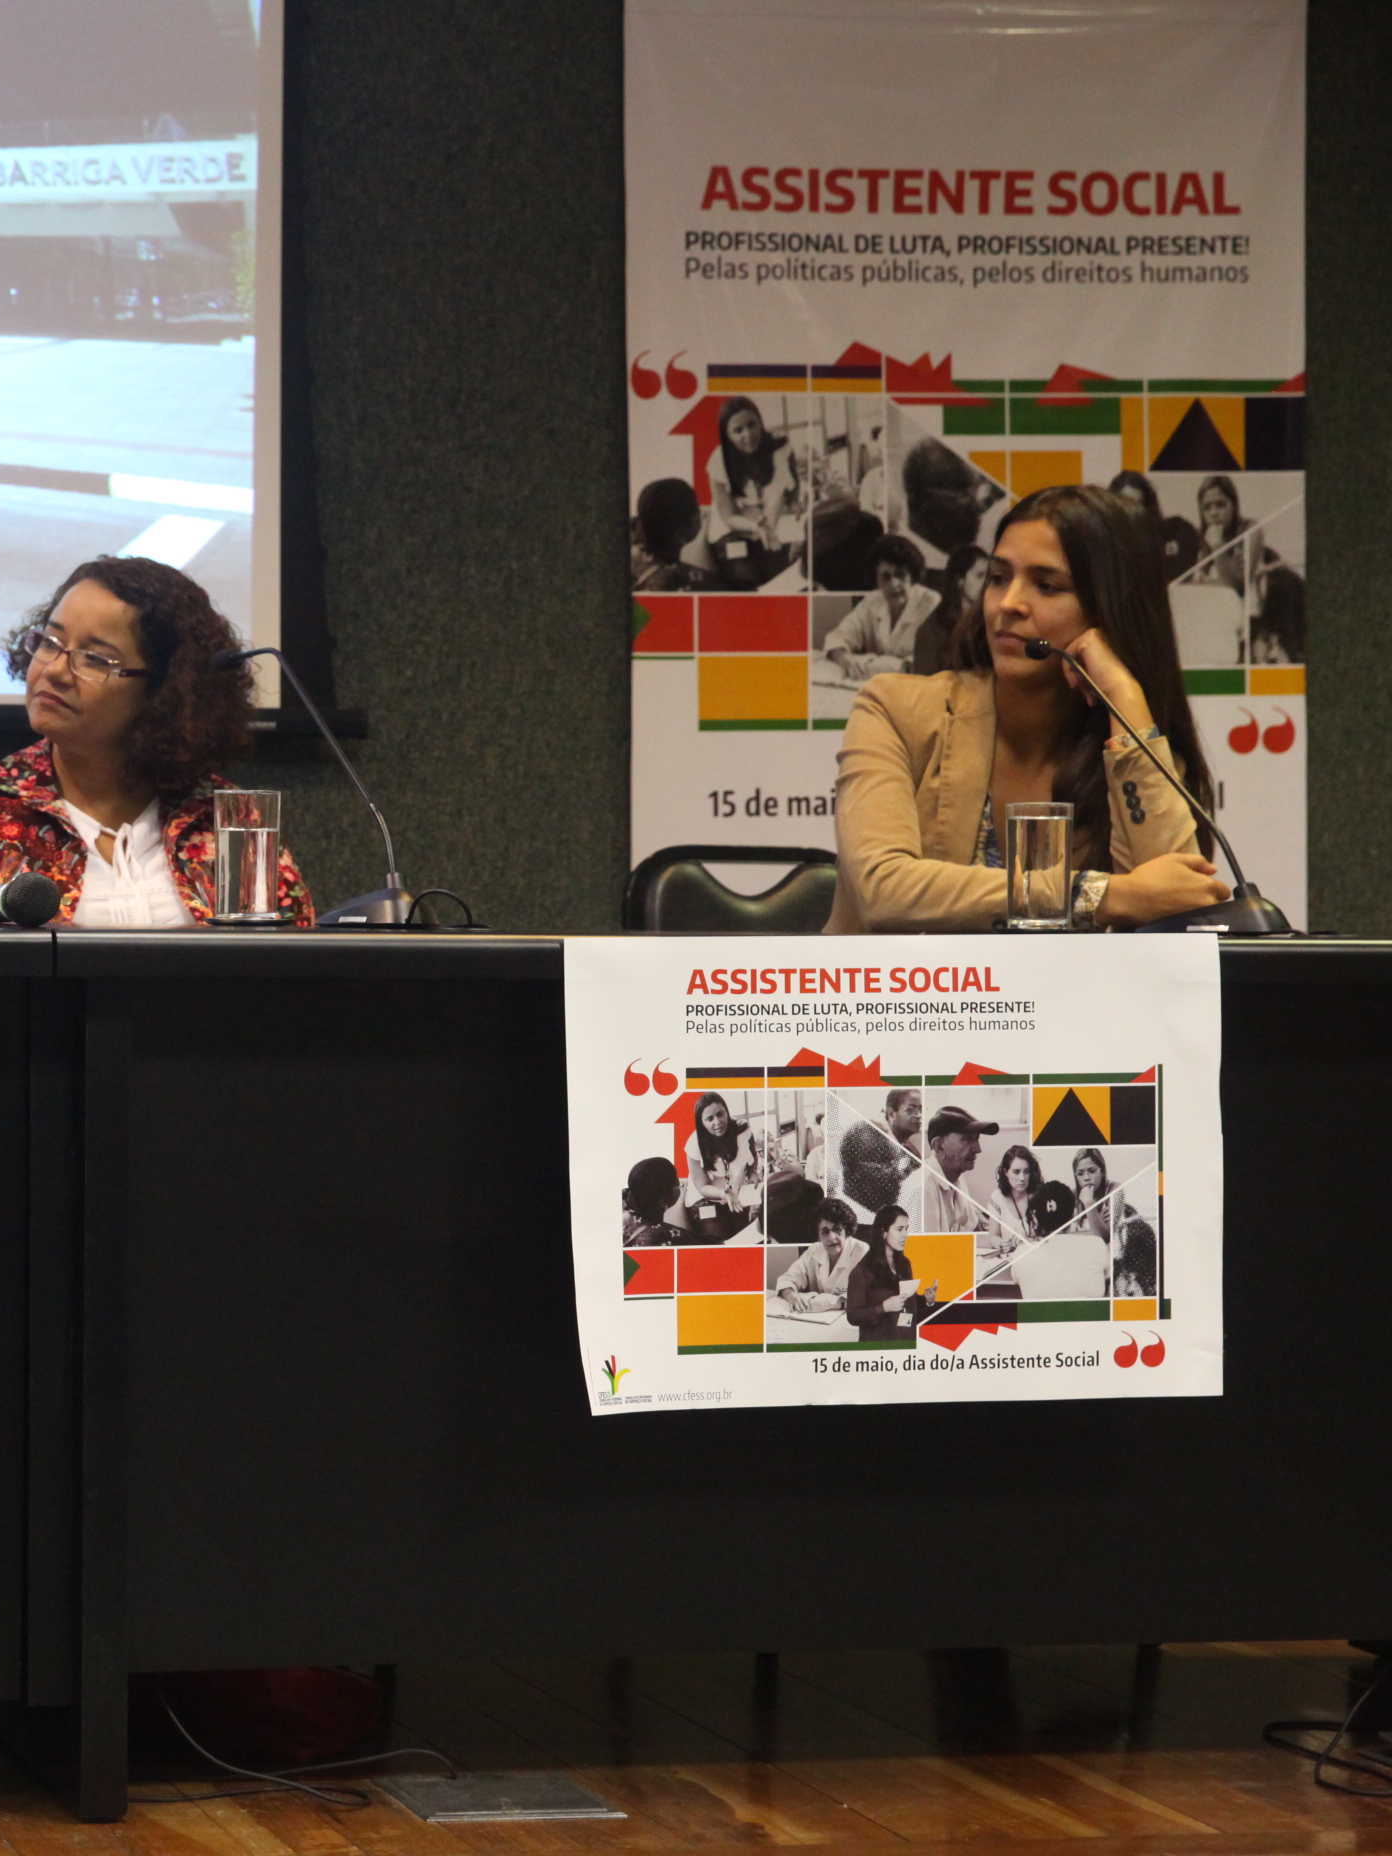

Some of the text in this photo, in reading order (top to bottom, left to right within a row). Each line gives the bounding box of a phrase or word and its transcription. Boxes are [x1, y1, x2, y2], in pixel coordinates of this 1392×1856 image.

[130, 152, 247, 185] VERDE
[700, 164, 1242, 218] ASSISTENTE SOCIAL
[684, 230, 1251, 258] PROFISSIONAL DE LUTA, PROFISSIONAL PRESENTE!
[684, 255, 1251, 288] Pelas políticas públicas, pelos direitos humanos
[707, 787, 836, 819] 15 de mai
[686, 966, 1001, 995] ASSISTENTE SOCIAL
[685, 1001, 1035, 1017] PROFISSIONAL DE LUTA, PROFISSIONAL PRESENTE!
[685, 1016, 1036, 1038] Pelas políticas públicas, pelos direitos humanos
[811, 1349, 1100, 1375] 15 de maio, dia do/a Assistente Social
[657, 1387, 733, 1403] www.cfess.org.br
